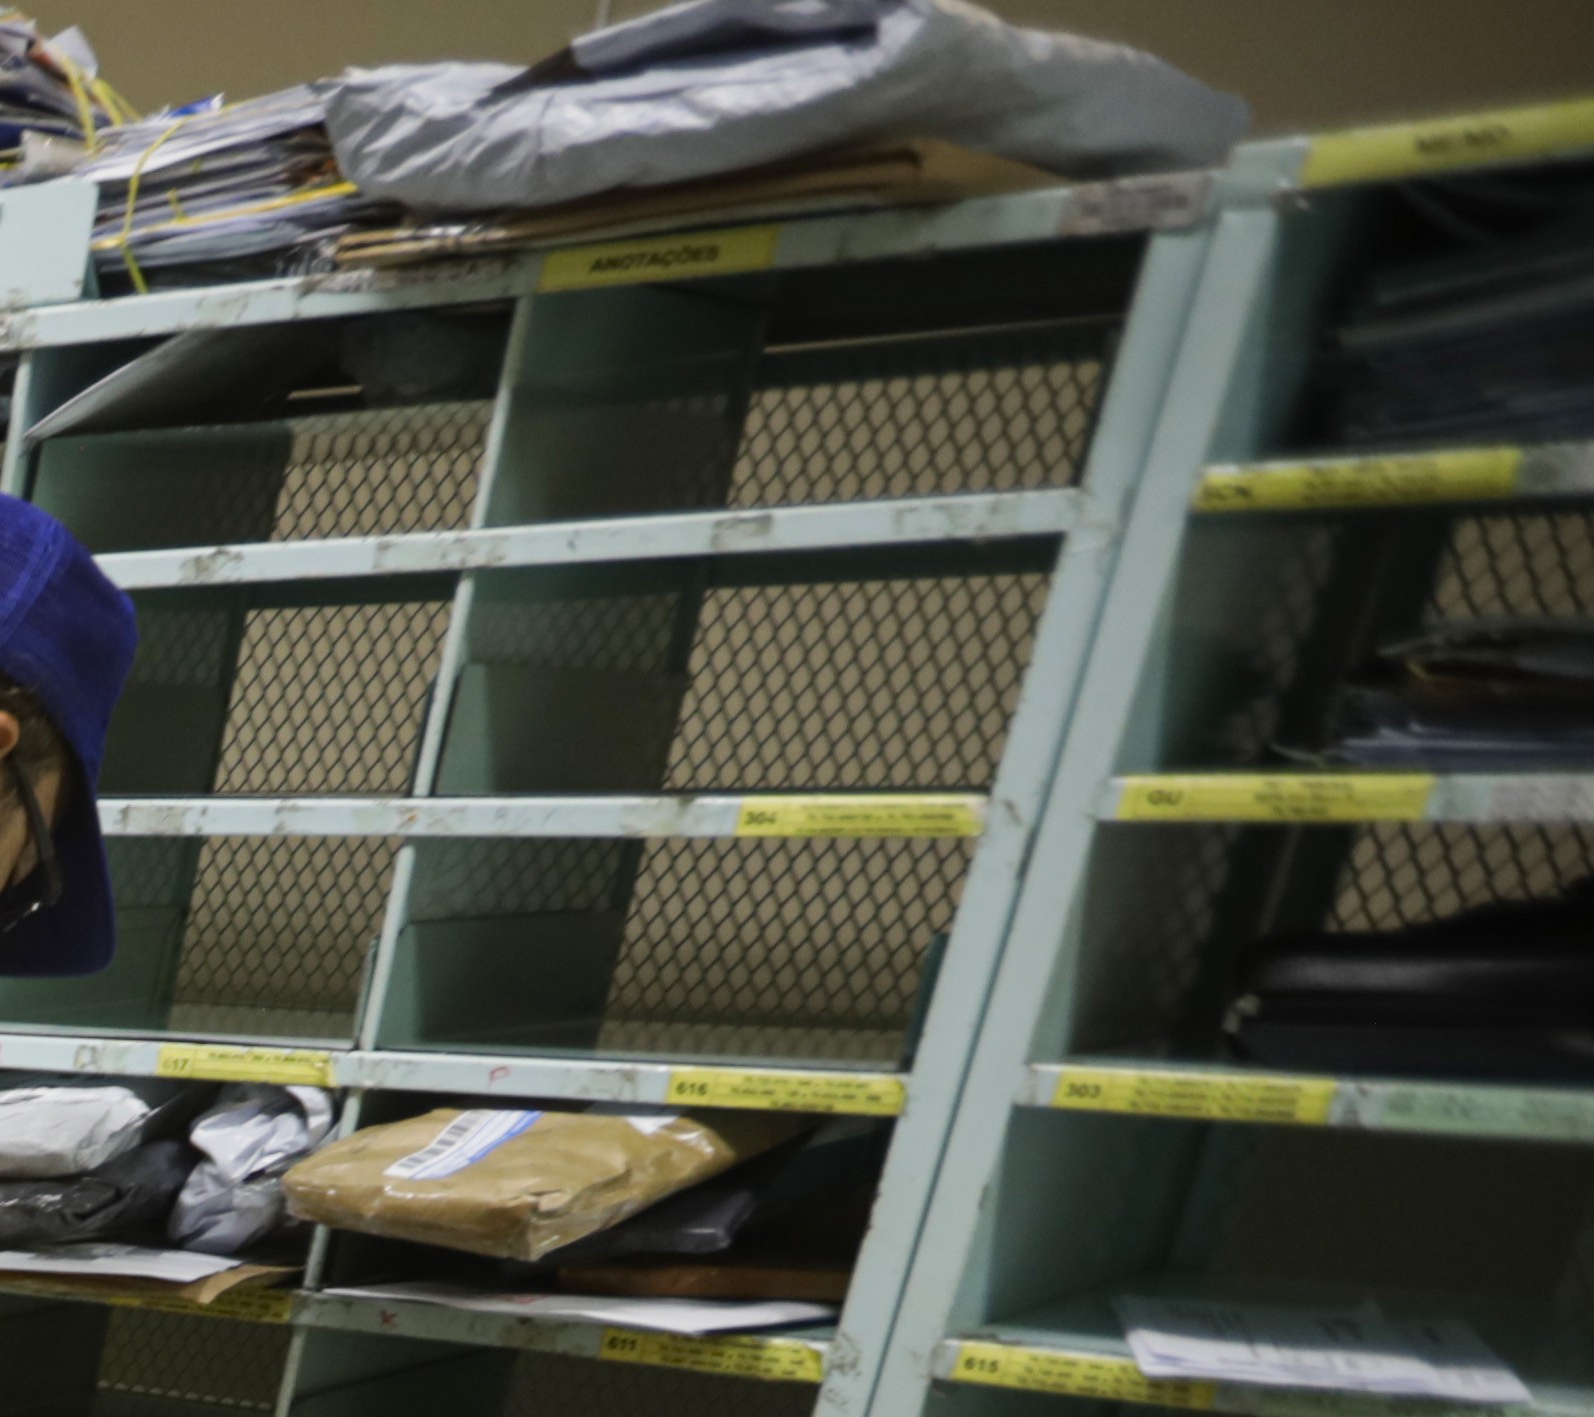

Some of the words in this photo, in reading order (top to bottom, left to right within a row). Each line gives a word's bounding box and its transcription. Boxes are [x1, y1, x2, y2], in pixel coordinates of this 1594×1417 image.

[589, 241, 721, 275] ANOTAÇÕES
[675, 1081, 708, 1097] 616
[1065, 1082, 1101, 1099] 303
[607, 1335, 638, 1351] 611
[964, 1357, 1000, 1374] 615
